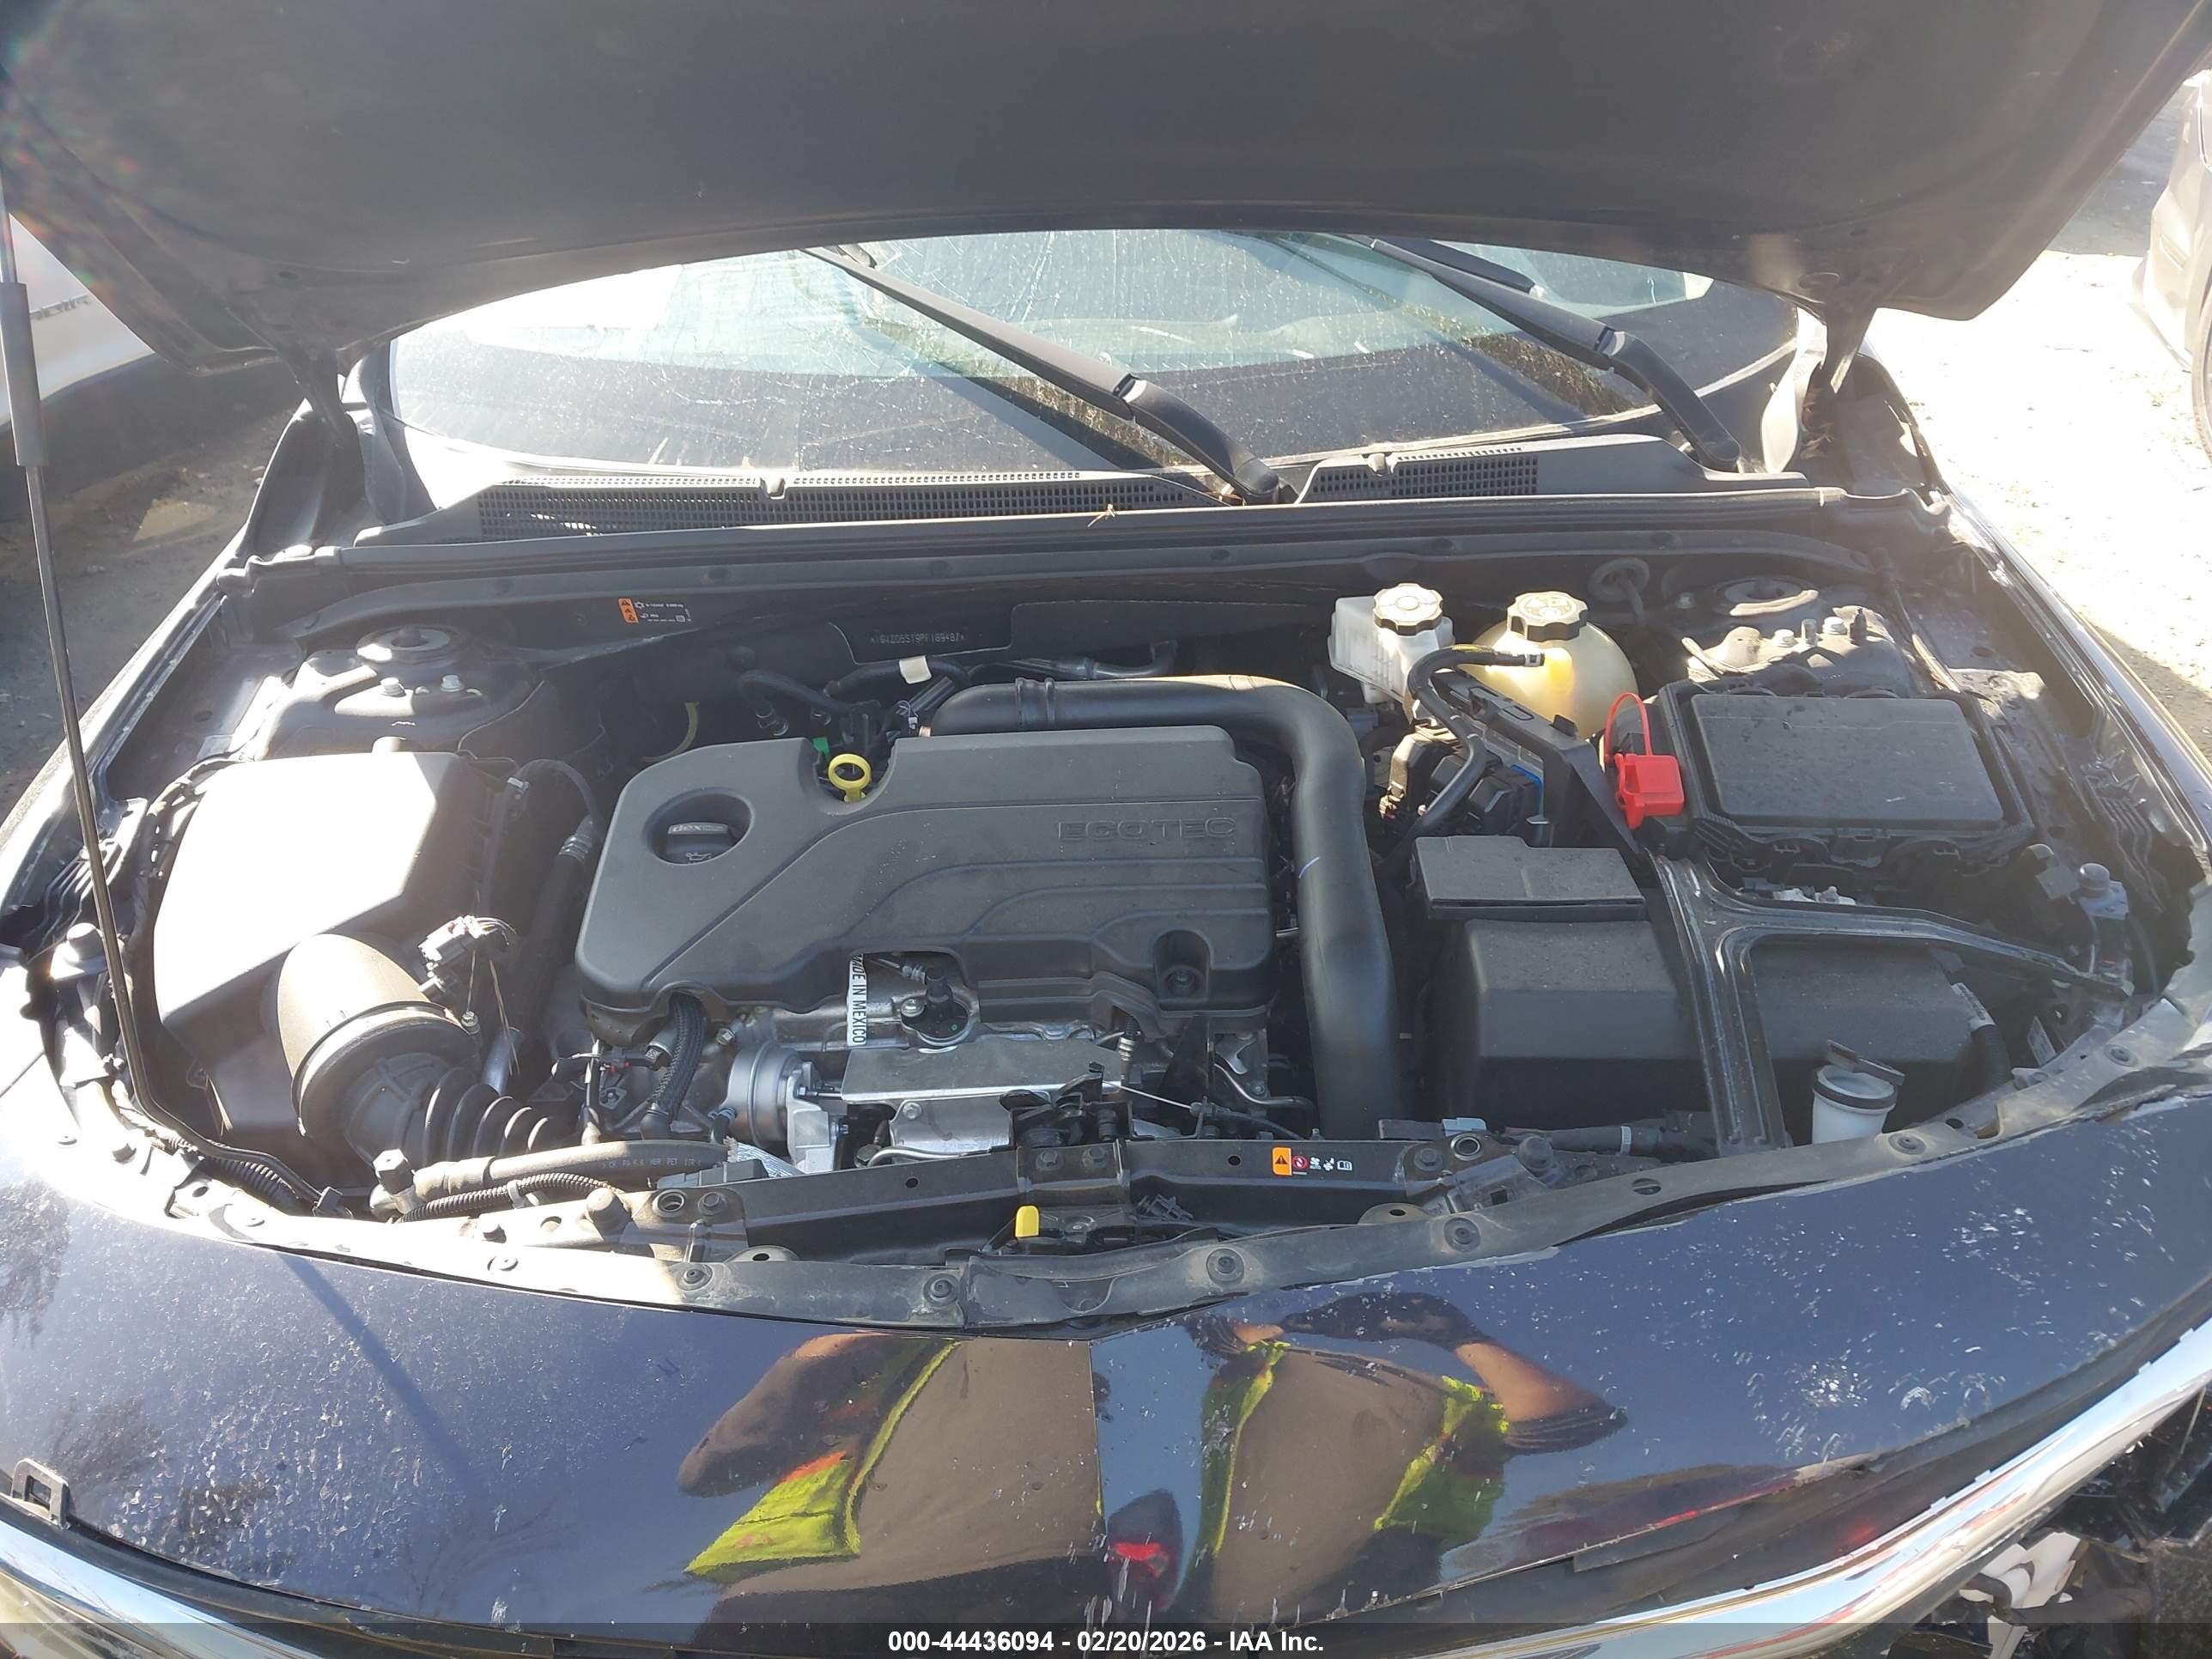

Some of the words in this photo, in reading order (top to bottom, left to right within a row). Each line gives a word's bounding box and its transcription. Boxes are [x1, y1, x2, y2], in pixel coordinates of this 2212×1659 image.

[1058, 817, 1236, 841] ECOTEC
[852, 984, 866, 996] IN
[852, 1000, 866, 1043] MEXICO
